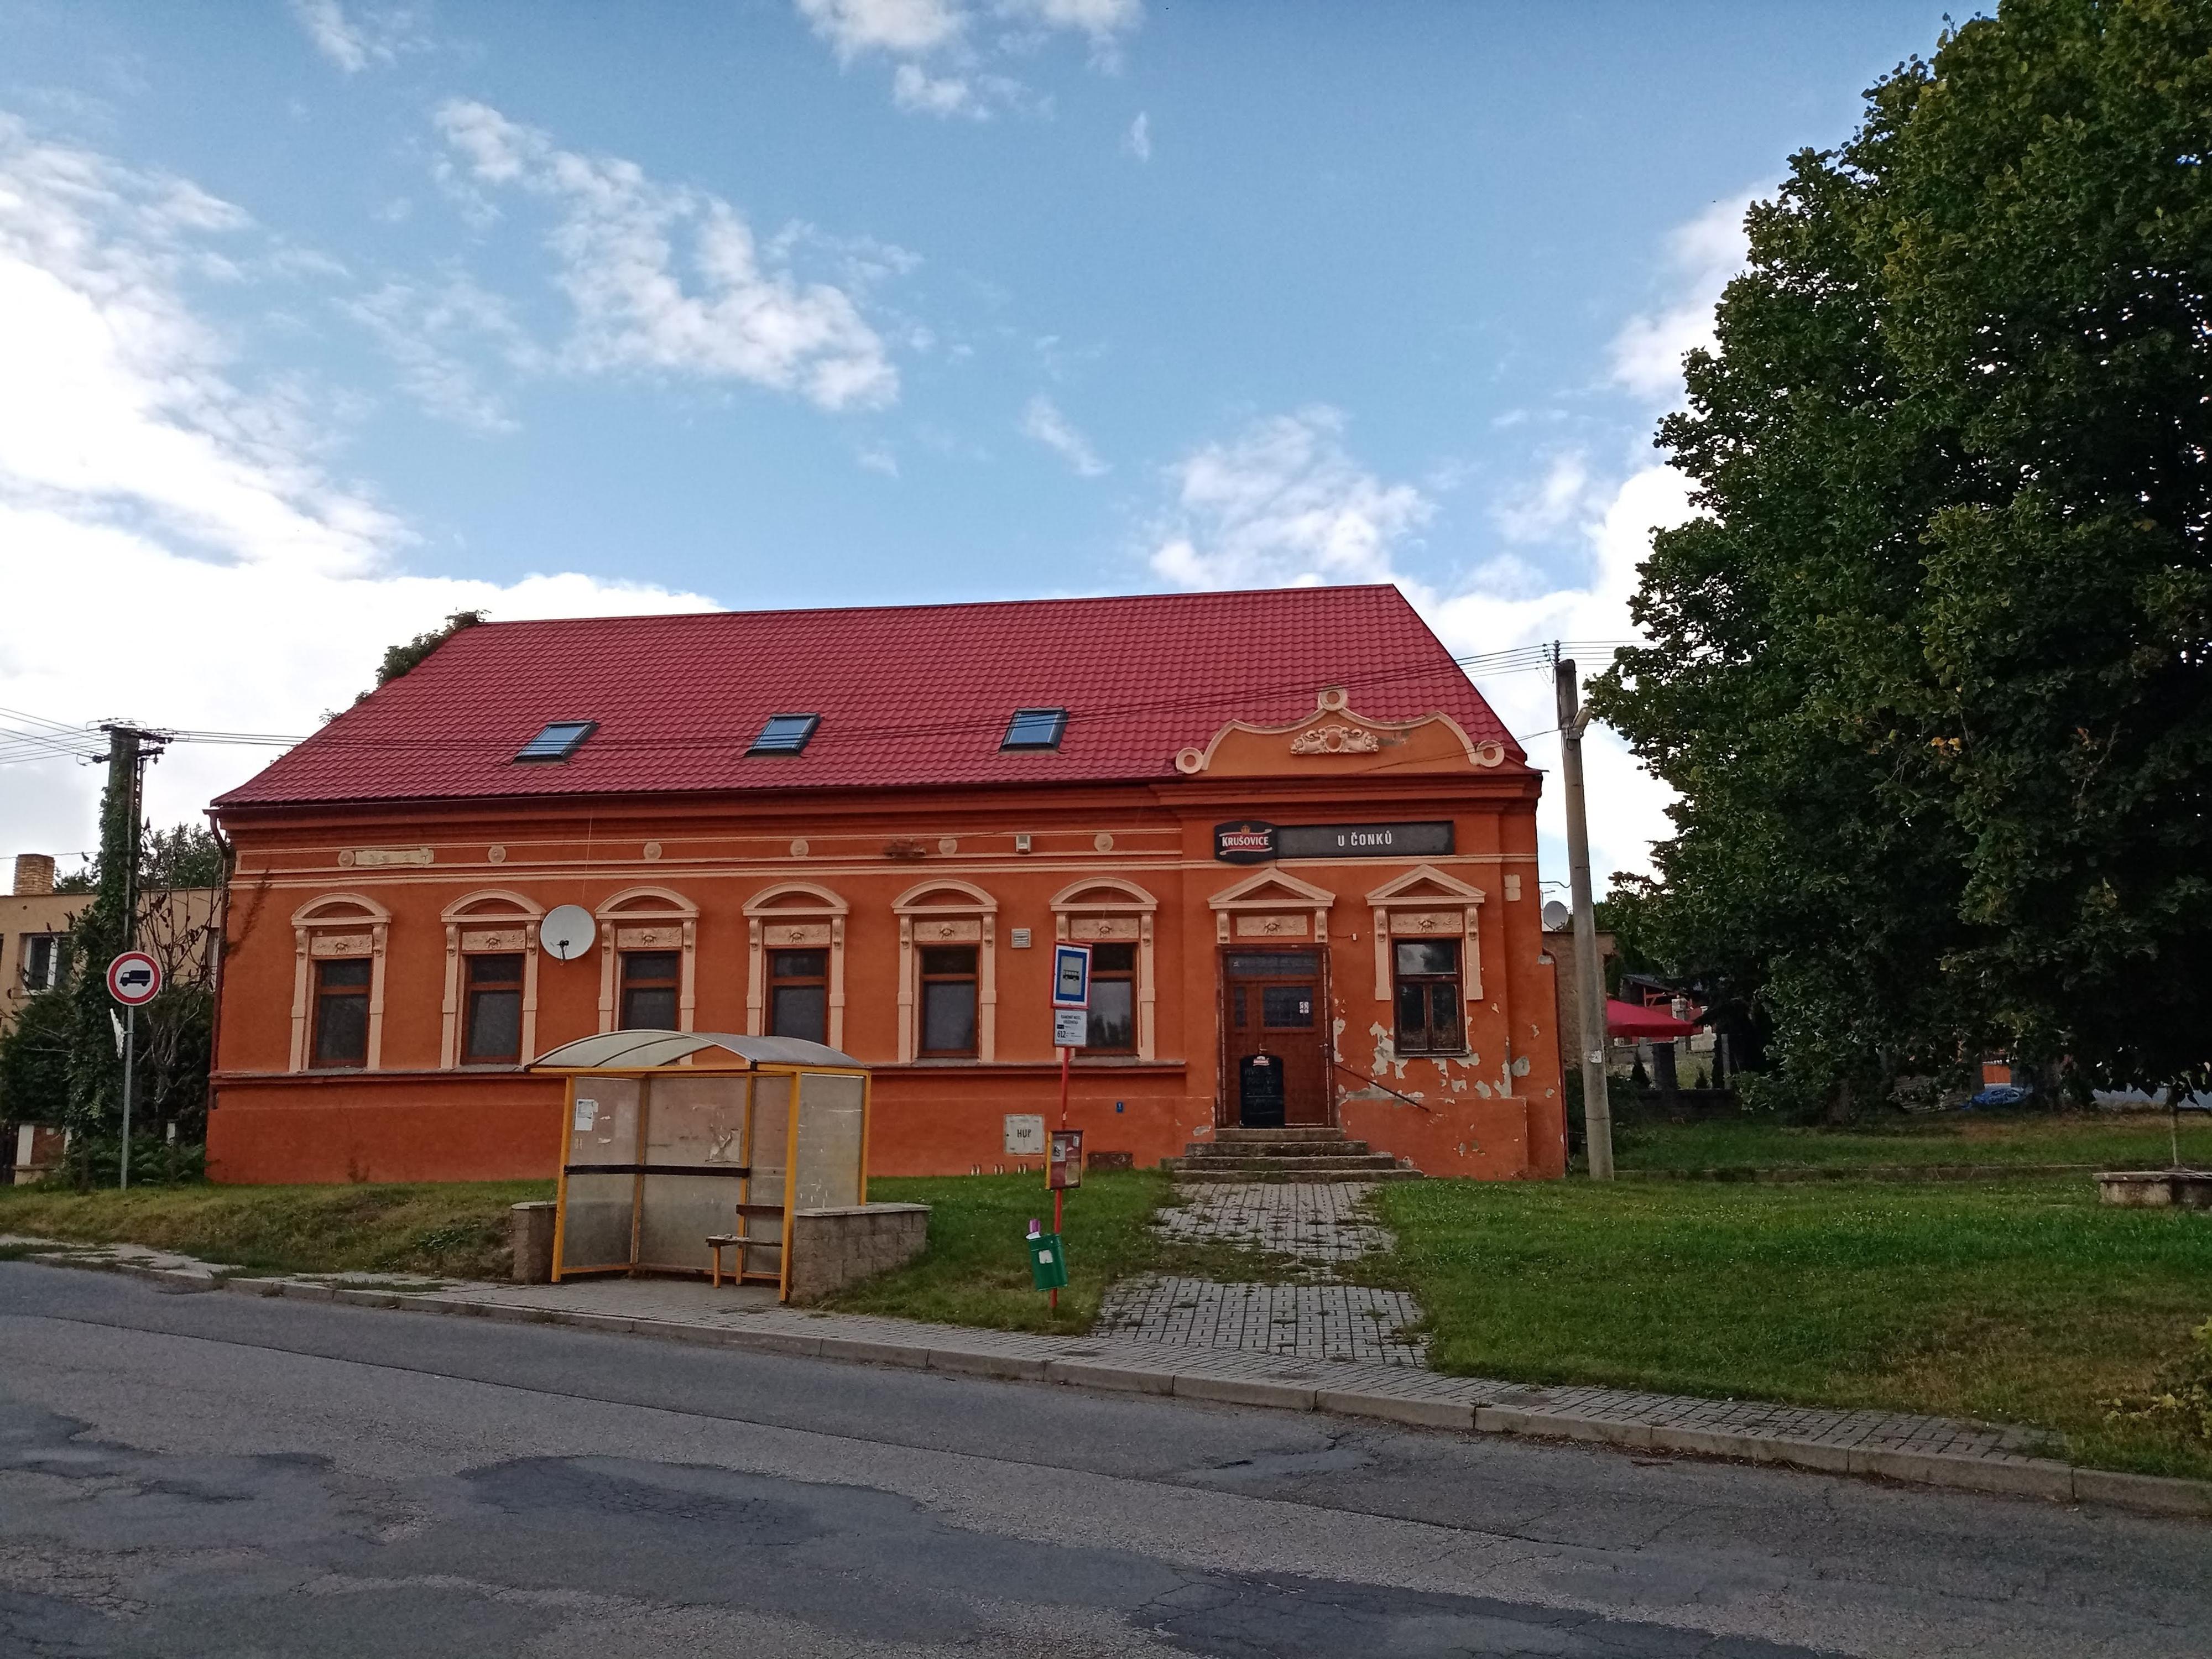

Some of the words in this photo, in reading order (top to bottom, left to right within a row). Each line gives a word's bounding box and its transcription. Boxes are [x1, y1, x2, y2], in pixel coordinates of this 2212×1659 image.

[1222, 835, 1269, 847] KRUŠOVICE
[1338, 835, 1344, 847] U
[1350, 830, 1392, 846] ČONKŮ
[1017, 1129, 1031, 1138] HUP
